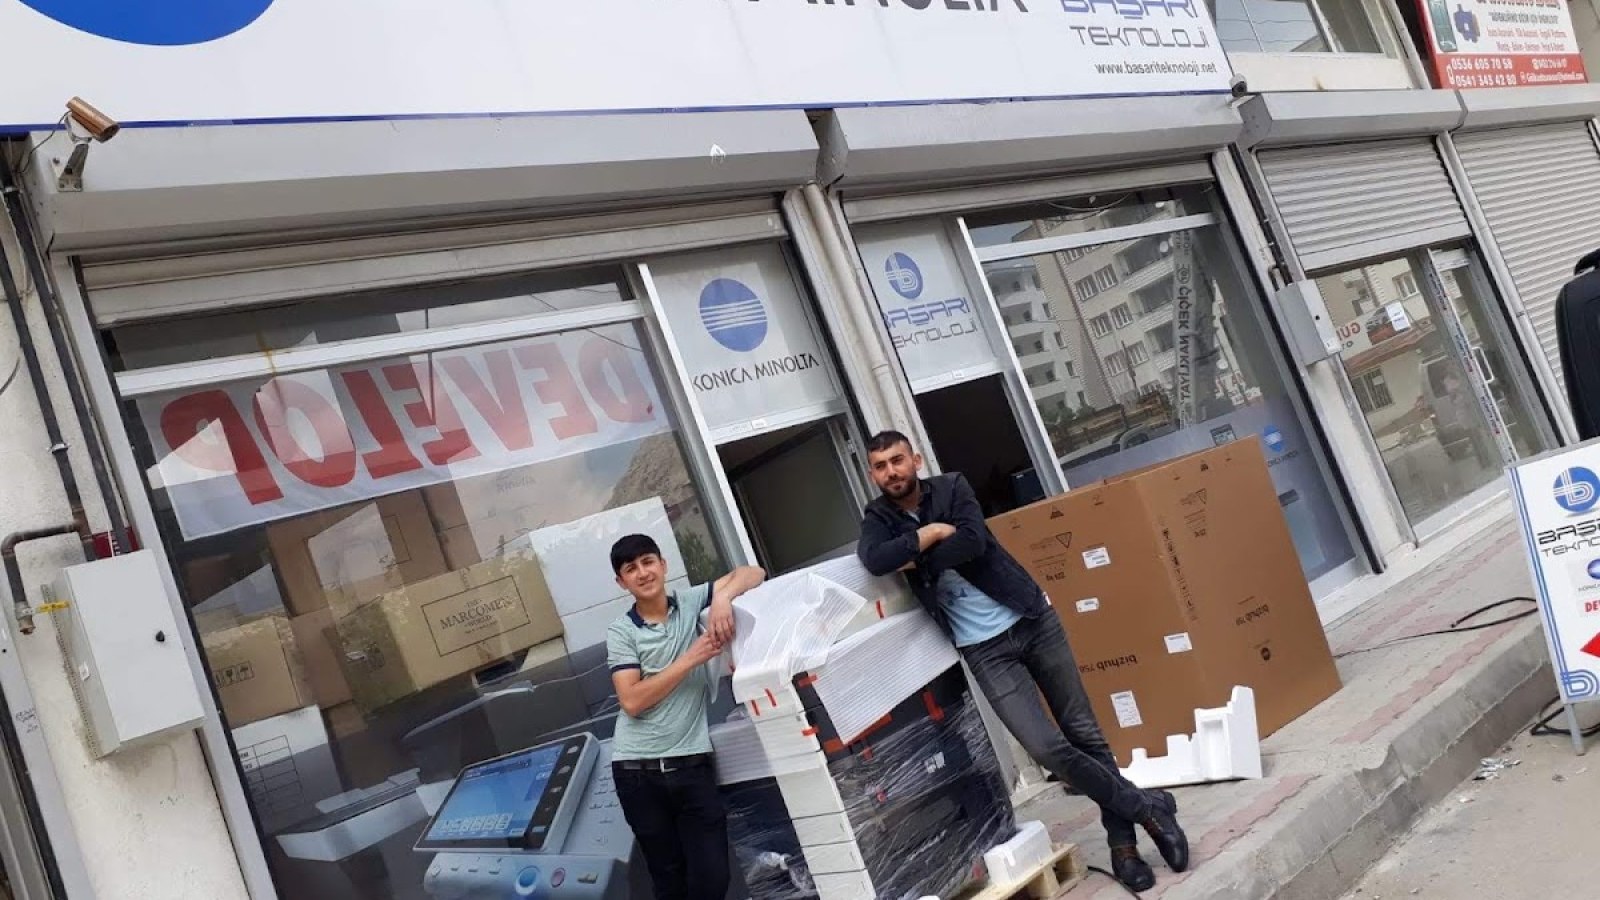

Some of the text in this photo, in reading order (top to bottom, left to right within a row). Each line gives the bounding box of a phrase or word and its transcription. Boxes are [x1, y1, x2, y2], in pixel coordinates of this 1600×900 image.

[1095, 60, 1218, 77] www.basariteknoloji.net
[884, 297, 970, 328] AŞARI
[755, 353, 819, 379] MINOLTA
[1096, 654, 1138, 672] bizhub
